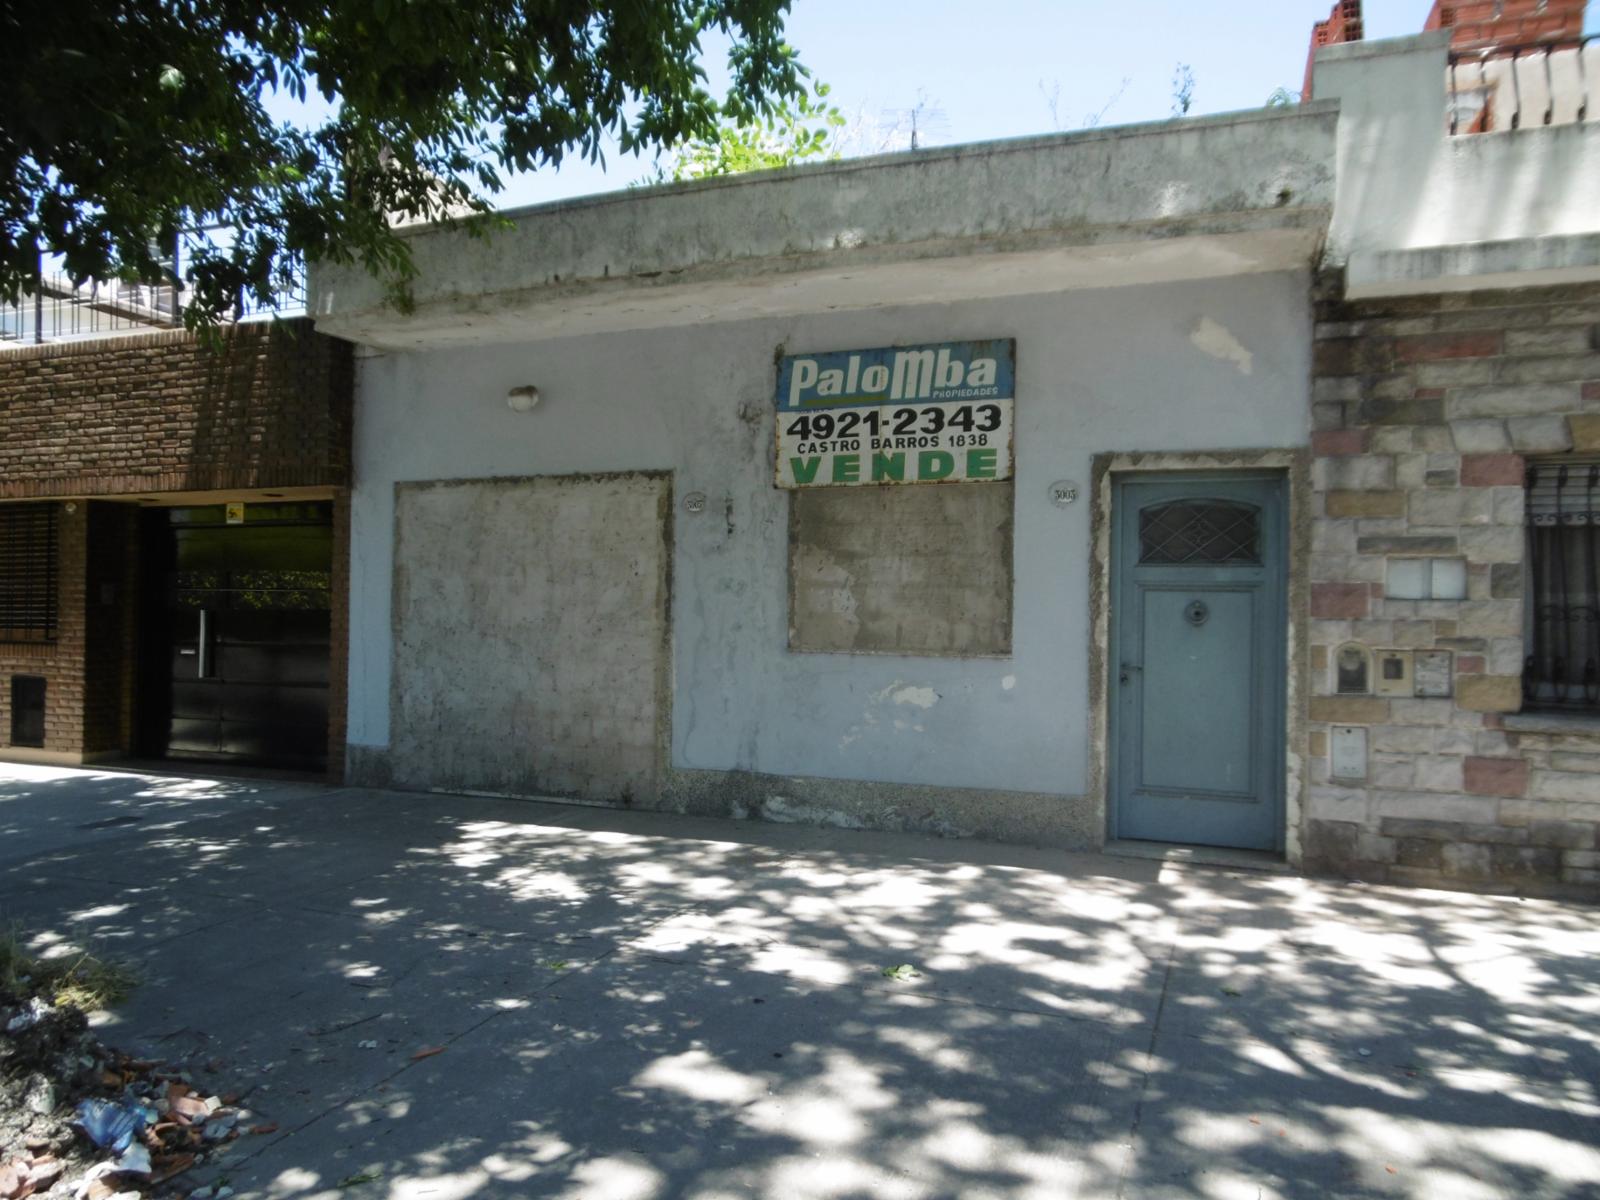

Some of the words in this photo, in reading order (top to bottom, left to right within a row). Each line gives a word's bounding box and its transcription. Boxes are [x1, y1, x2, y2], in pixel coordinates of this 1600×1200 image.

[932, 386, 999, 399] PROPIEDADES
[786, 404, 1002, 441] 4921-2343
[797, 439, 860, 454] CASTRO
[870, 436, 940, 450] BARROS
[948, 433, 988, 447] 1838
[789, 448, 998, 484] VENDE
